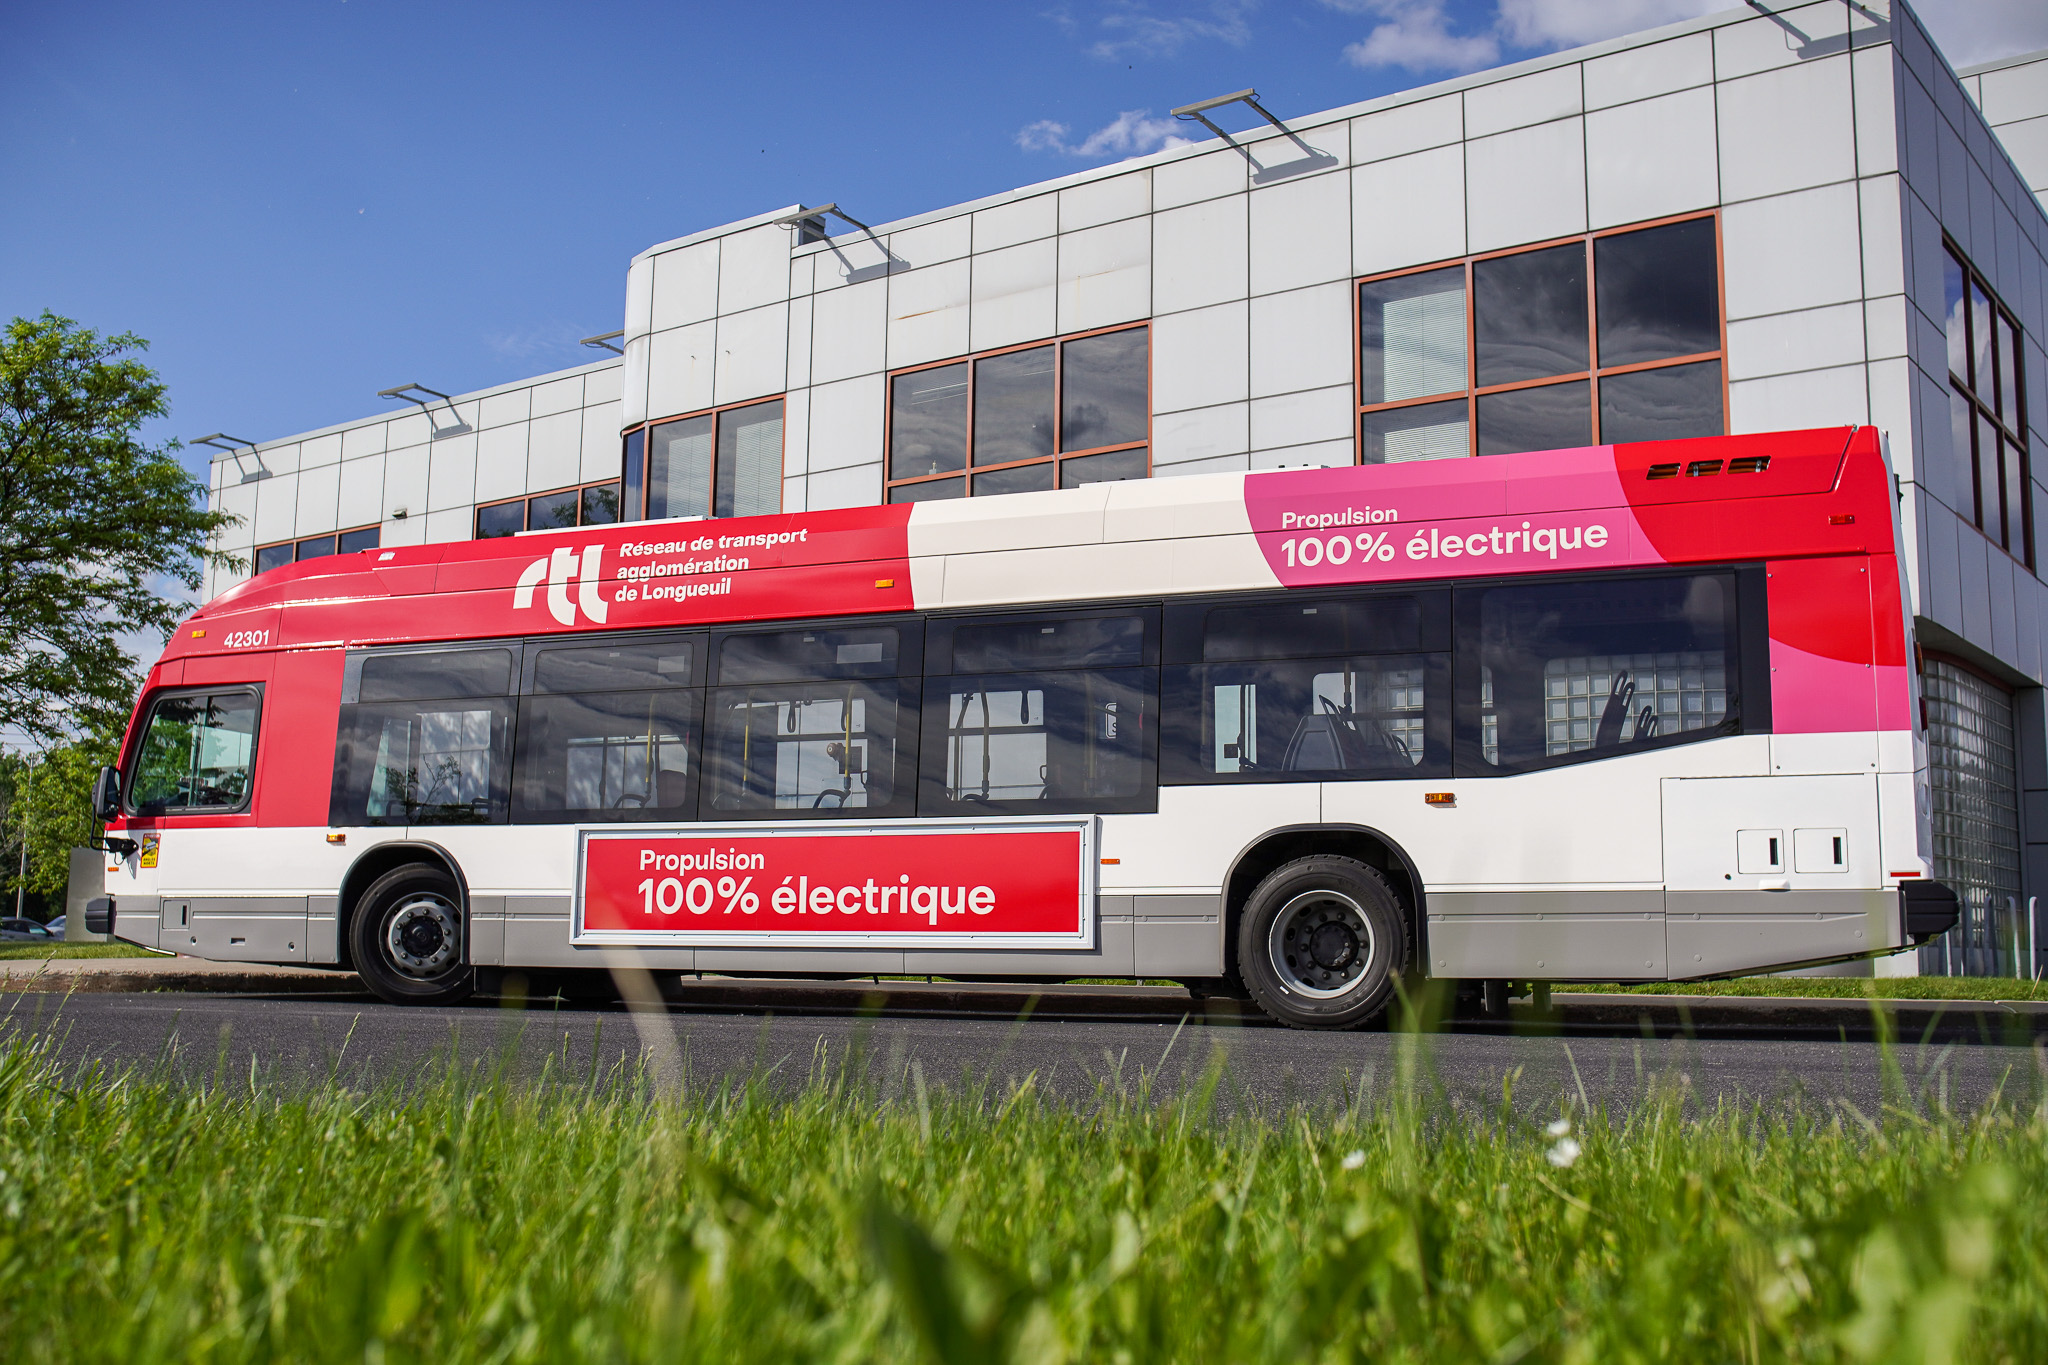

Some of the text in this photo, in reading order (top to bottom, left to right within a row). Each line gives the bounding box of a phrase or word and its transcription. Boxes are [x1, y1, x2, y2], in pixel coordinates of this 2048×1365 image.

[1281, 505, 1399, 531] Propulsion
[619, 528, 808, 557] Réseau de transport
[1281, 521, 1609, 567] 100% électrique
[616, 555, 750, 584] agglomération
[513, 544, 609, 626] rtl
[615, 578, 732, 603] de Longueuil
[223, 629, 270, 648] 42301
[639, 848, 766, 877] Propulsion
[638, 874, 996, 926] 100% électrique
